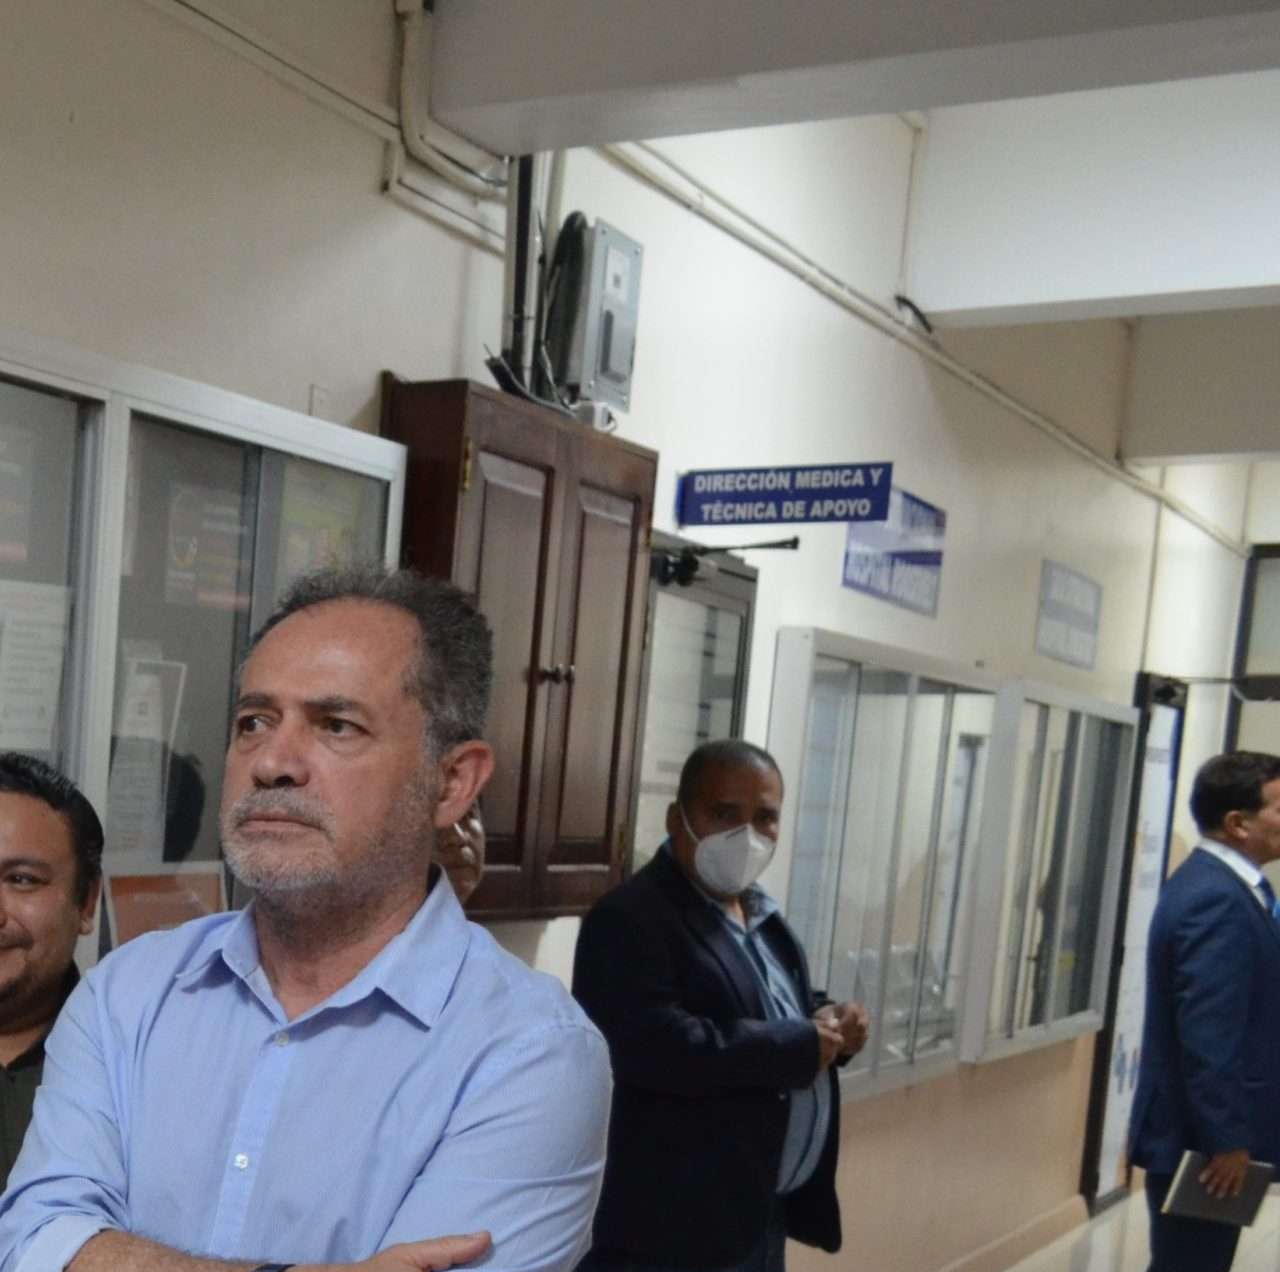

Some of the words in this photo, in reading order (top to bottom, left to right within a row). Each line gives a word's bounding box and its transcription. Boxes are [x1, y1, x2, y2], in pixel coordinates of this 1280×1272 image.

[694, 469, 790, 493] DIRECCIÓN
[794, 467, 865, 490] MEDICA
[869, 467, 884, 487] Y
[700, 501, 778, 522] TÉCNICA
[782, 500, 806, 519] DE
[810, 497, 871, 518] APOYO
